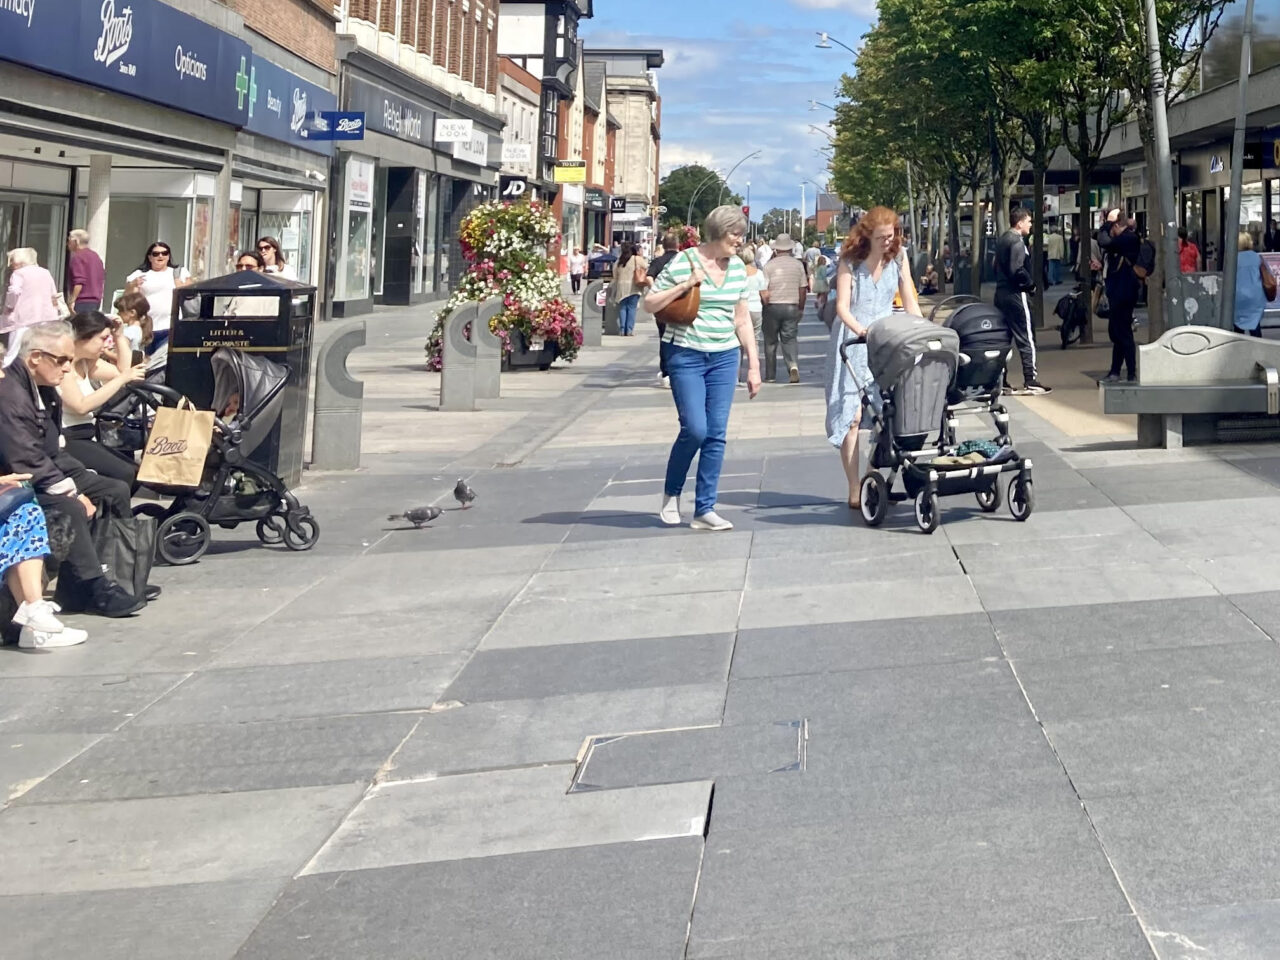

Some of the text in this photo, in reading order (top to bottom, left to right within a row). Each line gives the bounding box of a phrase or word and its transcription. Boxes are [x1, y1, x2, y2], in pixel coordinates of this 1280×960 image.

[175, 44, 207, 80] Opticians
[335, 118, 363, 131] Boots
[502, 180, 526, 195] JD
[614, 200, 624, 208] W
